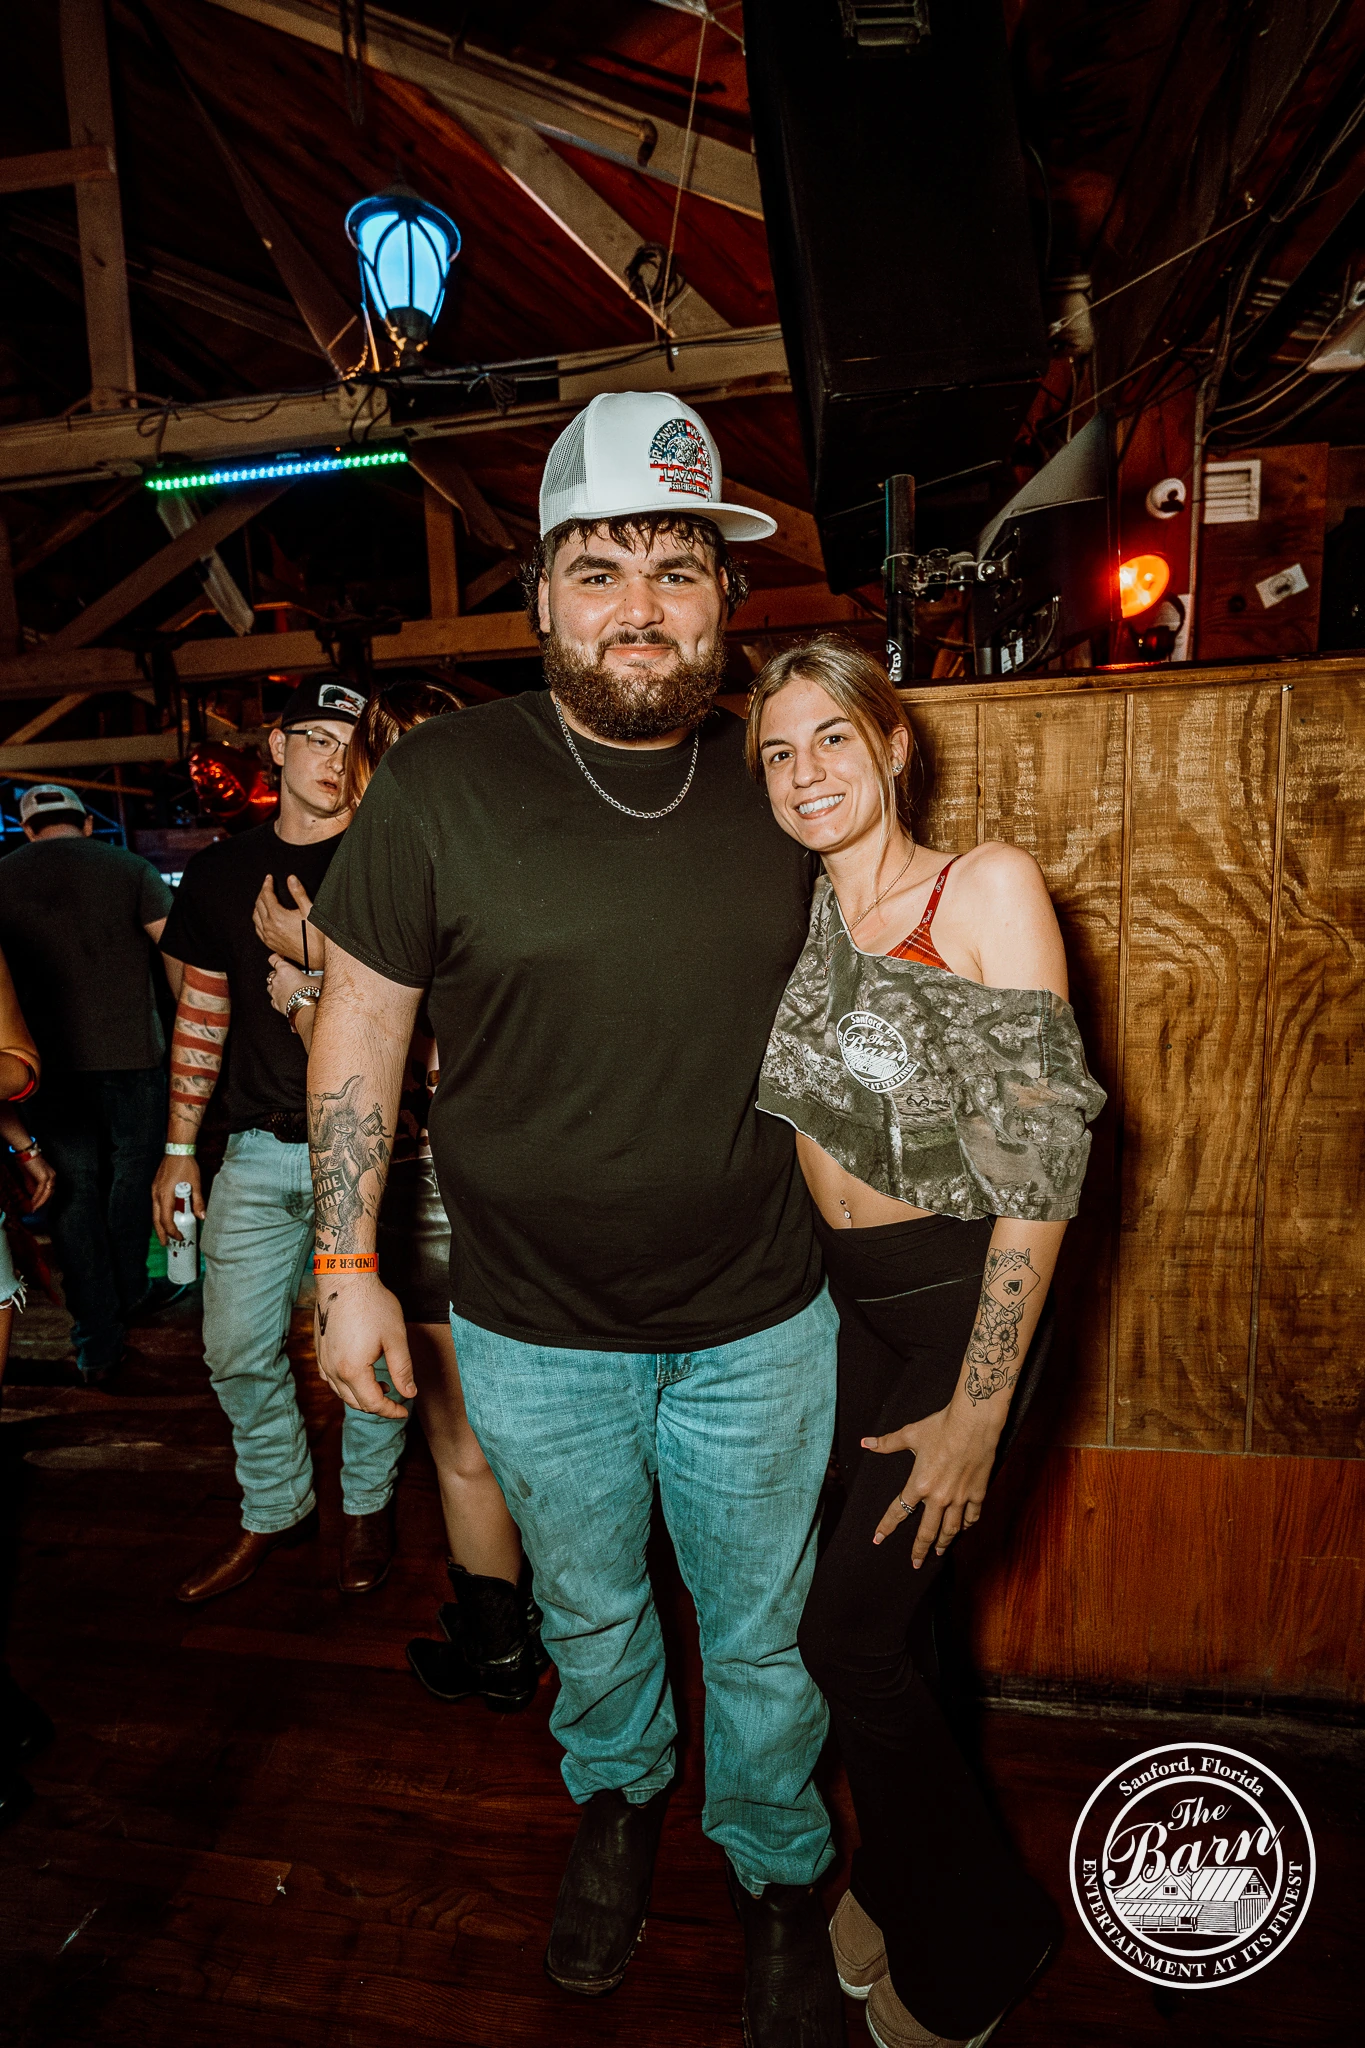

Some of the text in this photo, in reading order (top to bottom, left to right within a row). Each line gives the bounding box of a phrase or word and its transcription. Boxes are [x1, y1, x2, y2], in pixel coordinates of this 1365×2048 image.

[650, 420, 685, 460] RANCH
[663, 468, 697, 484] LAZY
[850, 1015, 884, 1032] Sanford,
[843, 1031, 911, 1062] Barn
[866, 1033, 893, 1047] The
[326, 1258, 336, 1269] 21
[340, 1257, 375, 1269] UNDER
